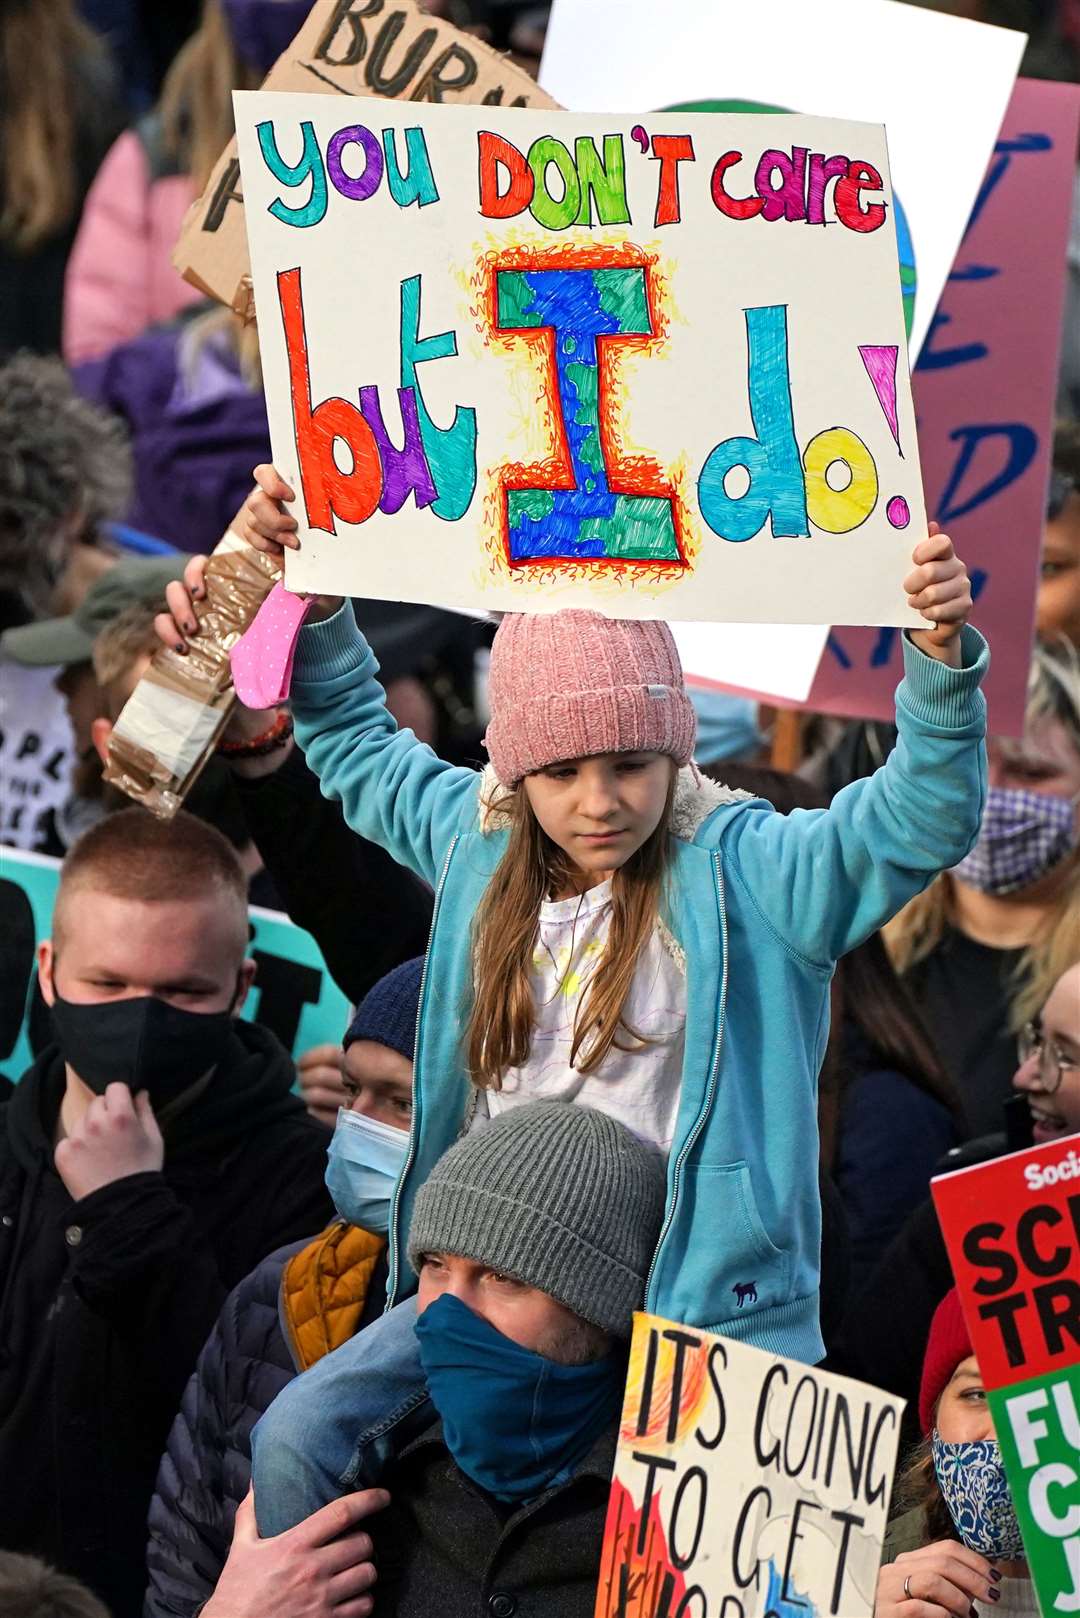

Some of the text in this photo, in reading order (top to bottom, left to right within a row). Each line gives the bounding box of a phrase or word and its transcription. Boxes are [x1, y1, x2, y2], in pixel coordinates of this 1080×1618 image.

[315, 0, 529, 107] BUR
[476, 125, 697, 231] DON'T
[711, 145, 890, 233] care
[276, 262, 911, 566] but I do!
[1024, 1151, 1080, 1190] Soci
[636, 1328, 896, 1509] ITS GOING
[632, 1450, 708, 1571] TO
[732, 1485, 865, 1616] GET
